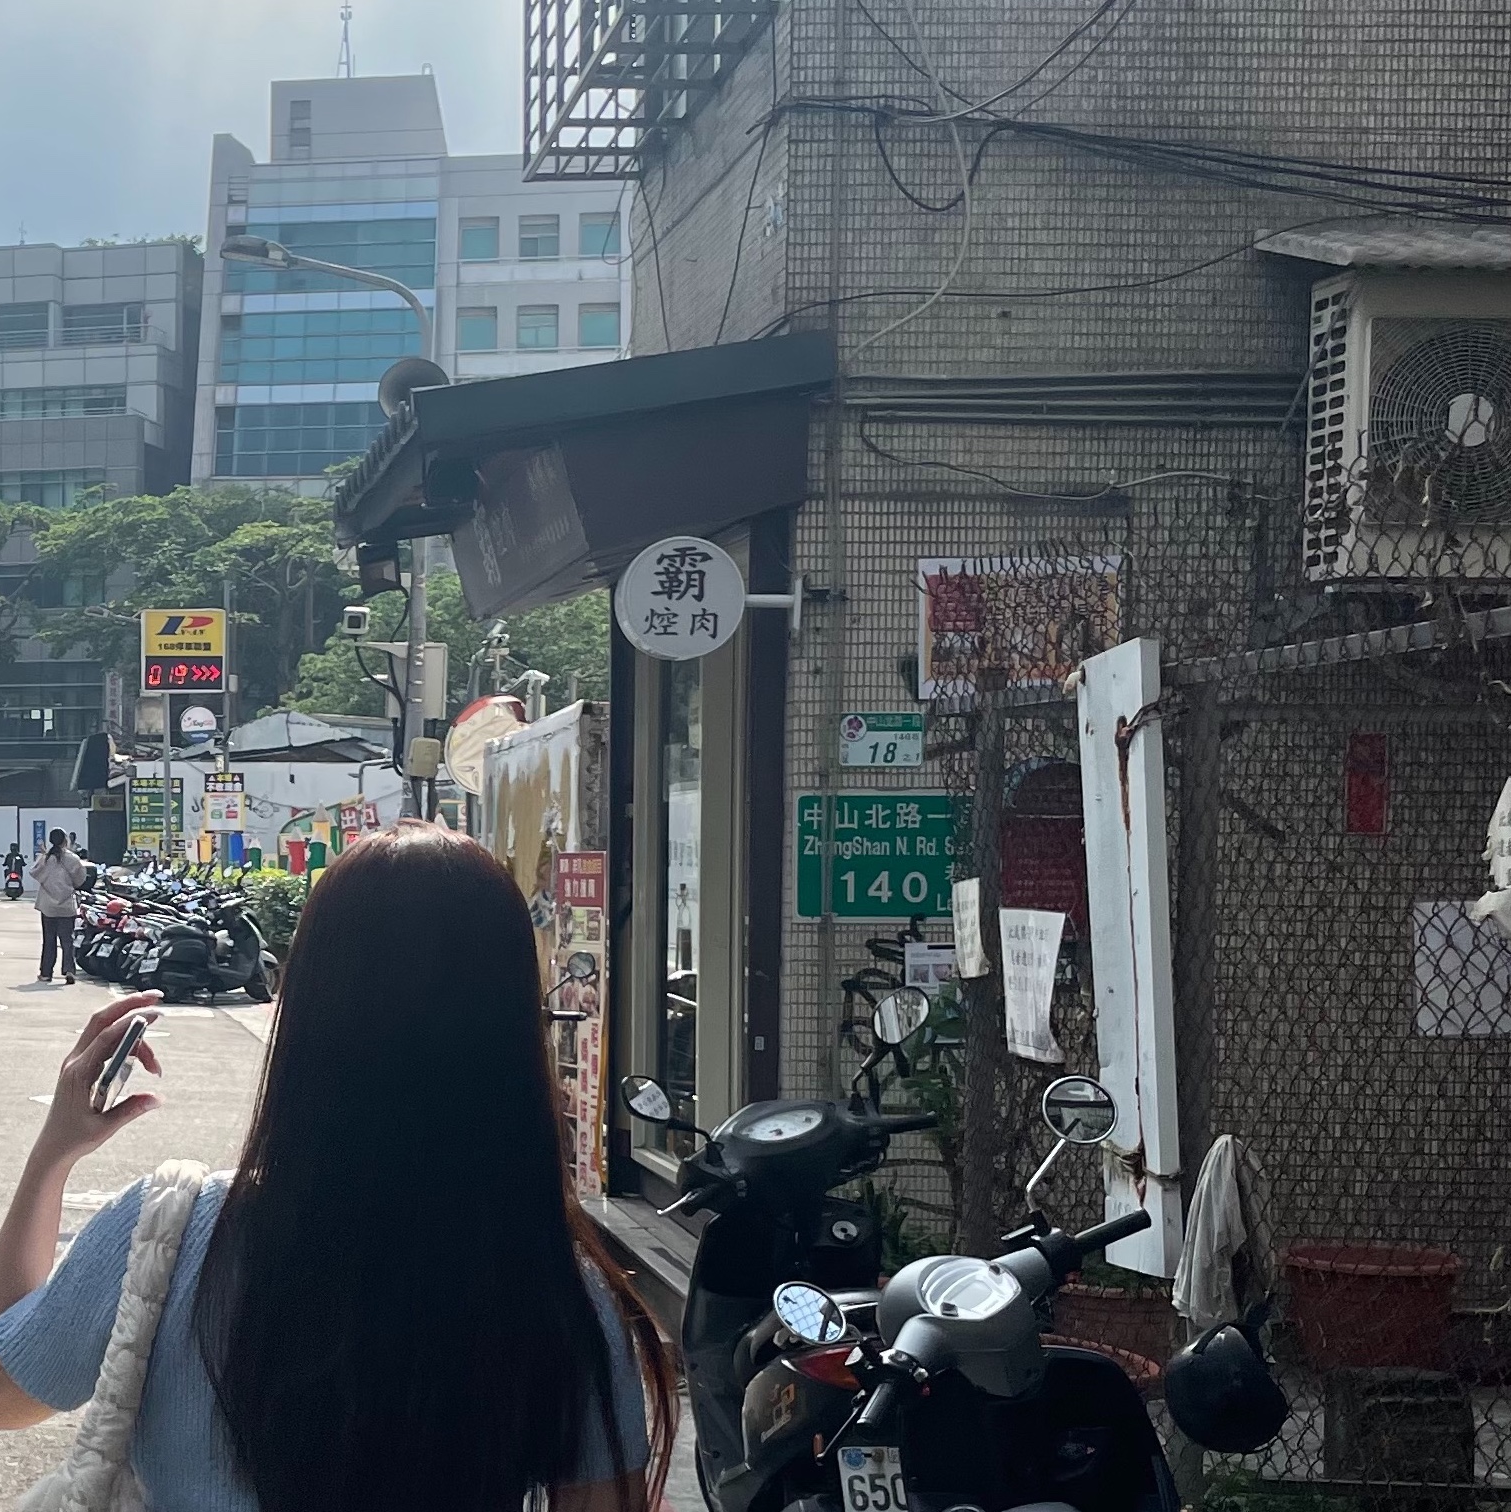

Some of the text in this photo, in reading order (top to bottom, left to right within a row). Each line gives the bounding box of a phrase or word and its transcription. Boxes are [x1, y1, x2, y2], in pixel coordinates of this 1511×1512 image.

[651, 546, 713, 602] 霸
[868, 741, 898, 764] 18
[803, 835, 890, 860] ZhngShan
[896, 836, 911, 856] N.
[916, 836, 939, 856] Rd.
[840, 871, 928, 903] 140
